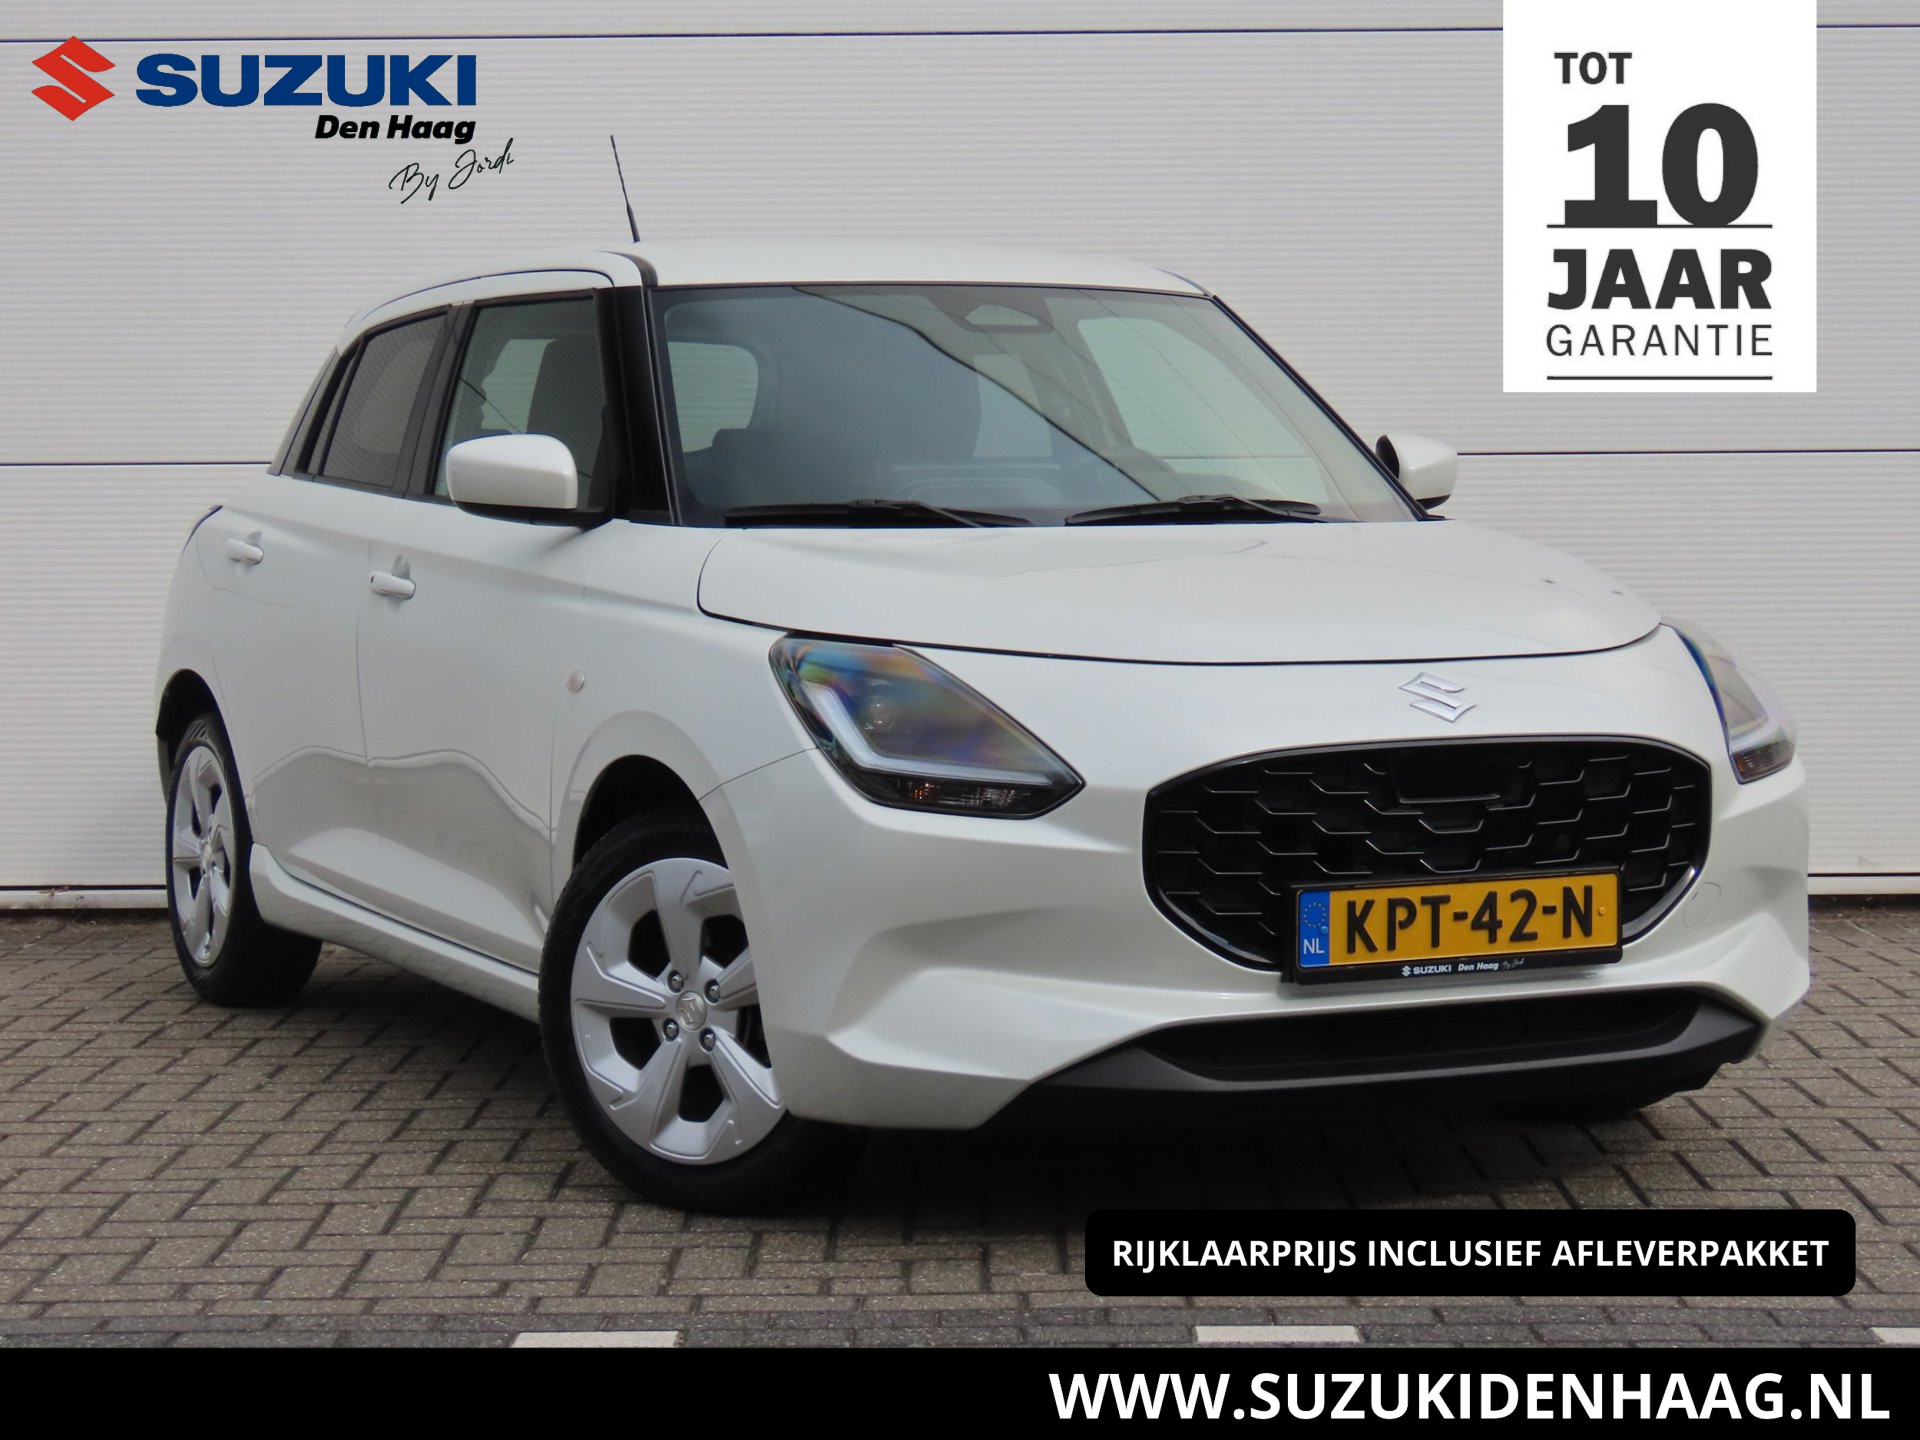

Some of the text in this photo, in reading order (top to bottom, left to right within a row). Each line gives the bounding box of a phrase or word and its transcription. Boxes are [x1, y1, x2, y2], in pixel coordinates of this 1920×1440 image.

[1347, 885, 1593, 954] KPT-42-N
[1303, 938, 1325, 955] NL
[1413, 964, 1452, 975] SUZUKI
[1458, 963, 1475, 972] Den
[1476, 962, 1499, 971] Haag
